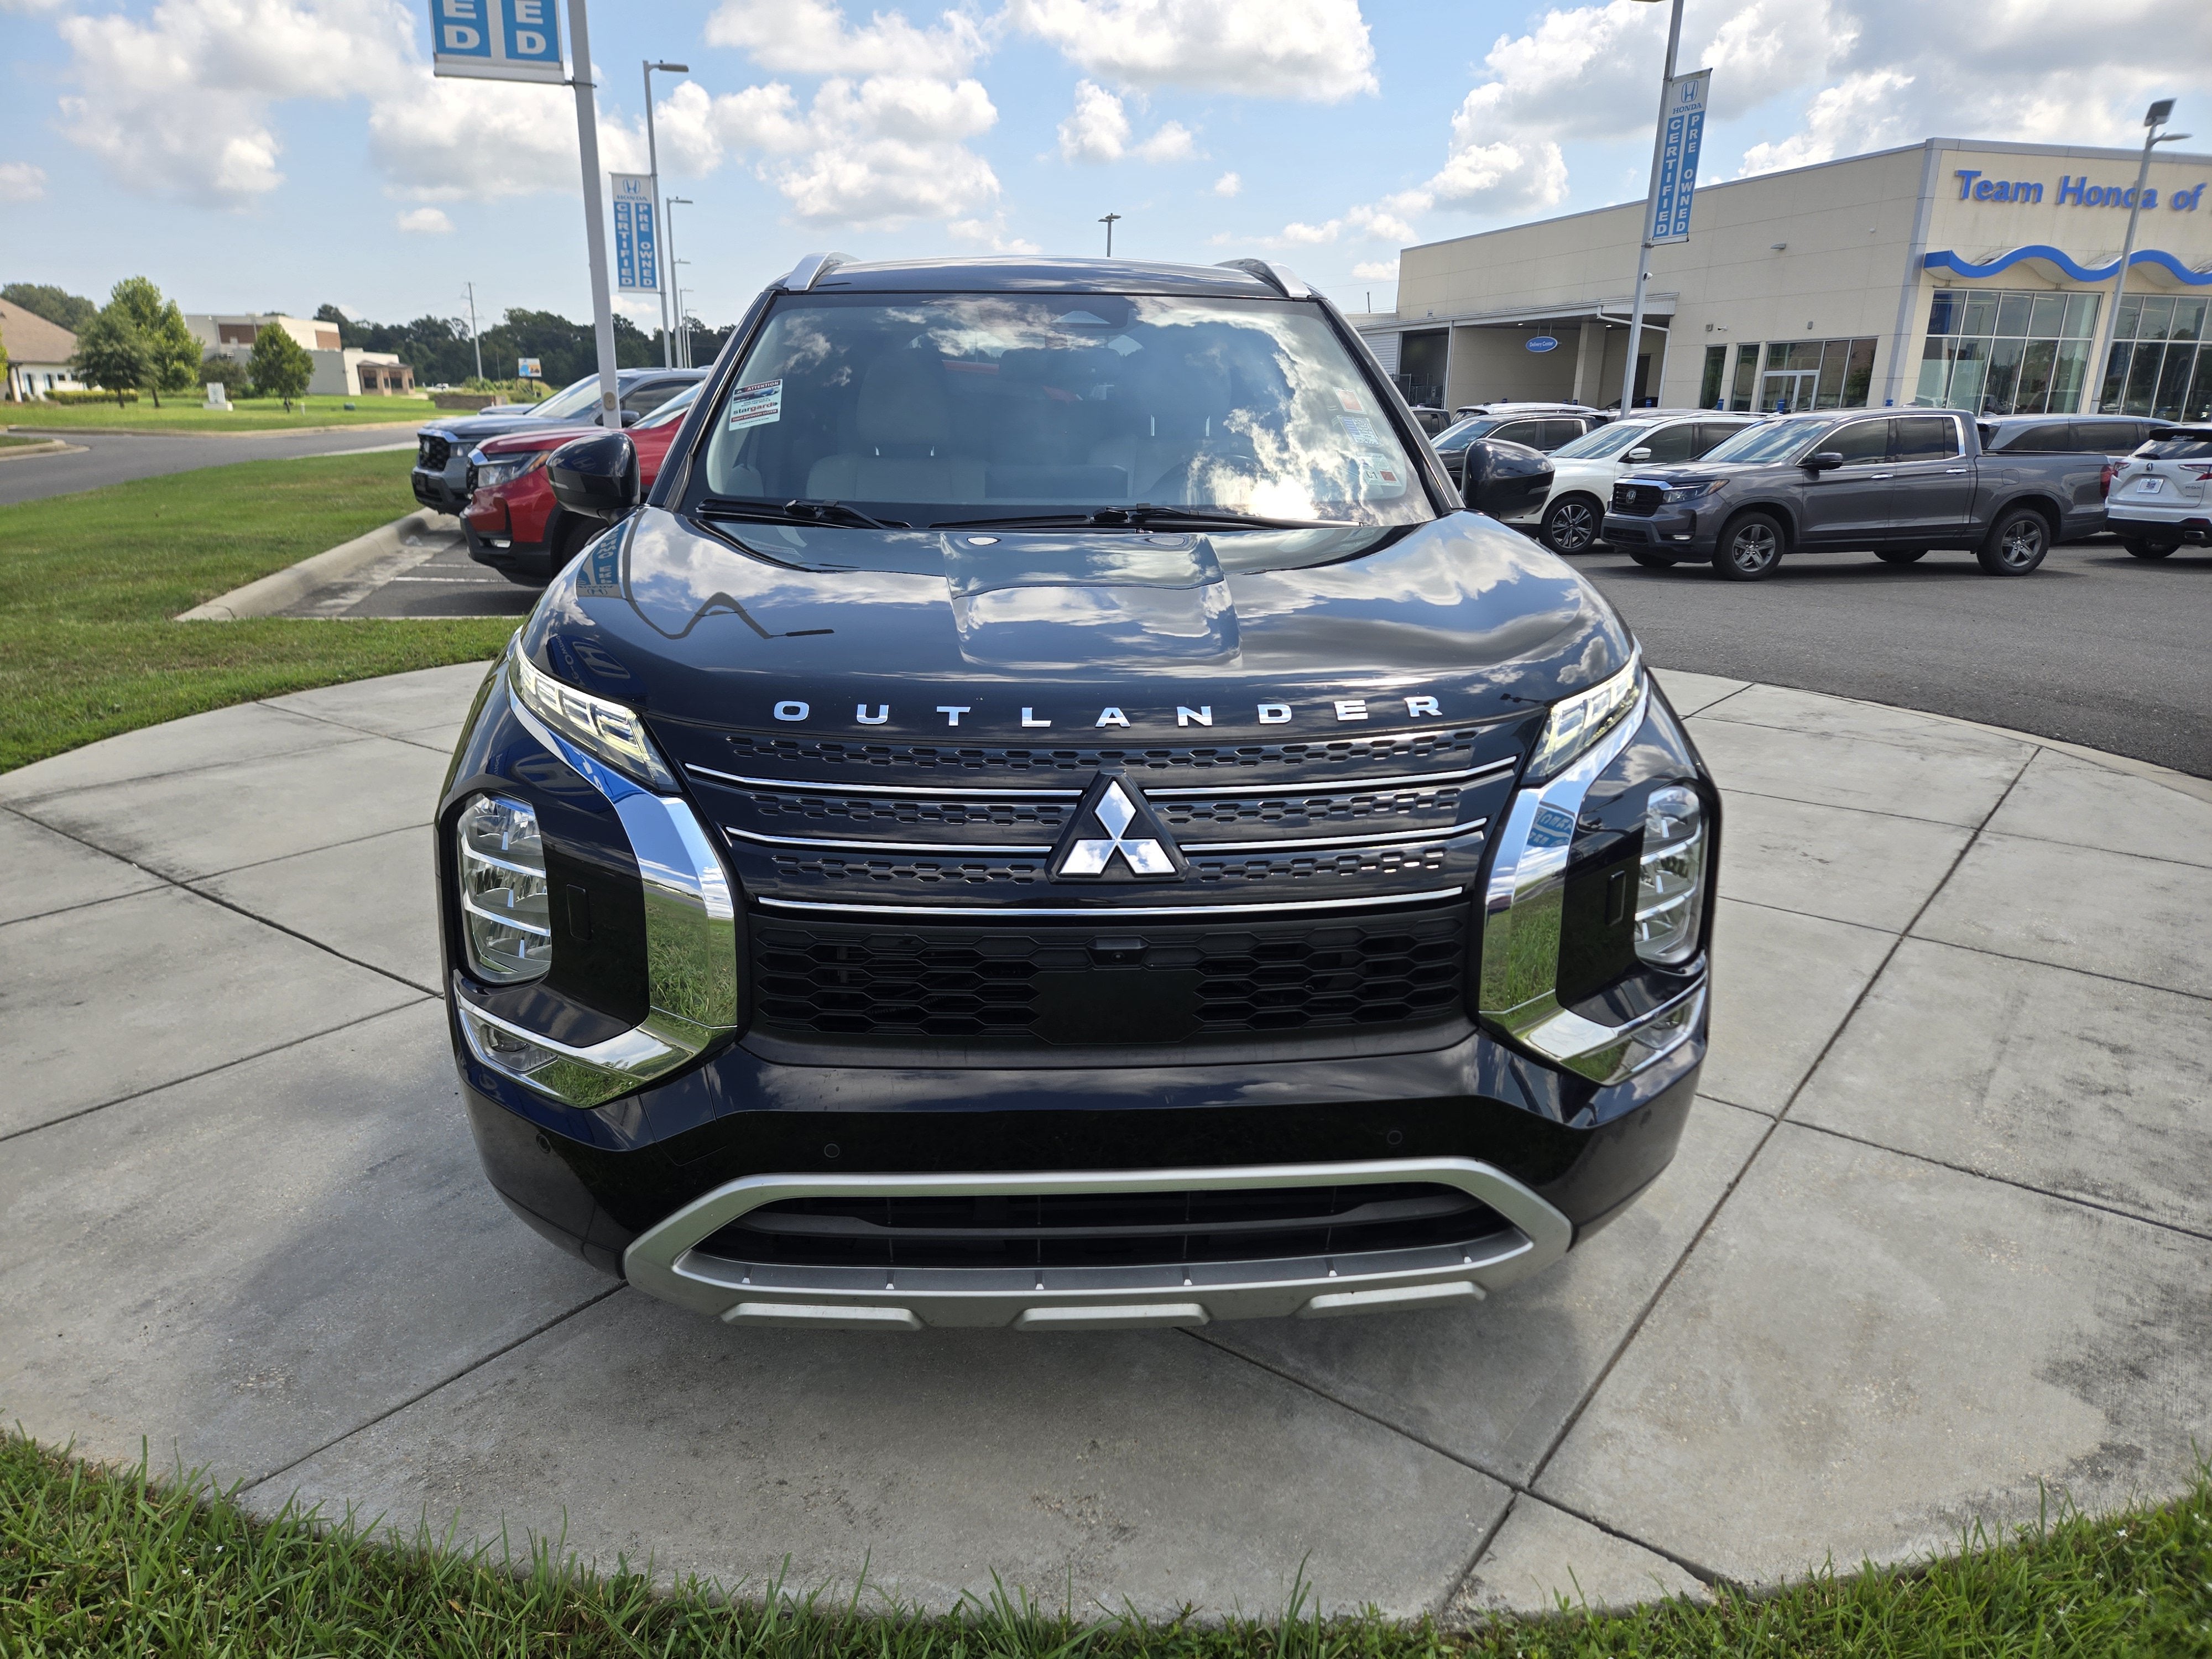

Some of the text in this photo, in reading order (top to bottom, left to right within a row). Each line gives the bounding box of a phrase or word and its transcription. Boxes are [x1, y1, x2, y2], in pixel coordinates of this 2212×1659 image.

[1673, 102, 1702, 114] HONDA
[1656, 119, 1682, 235] CERTIFIED
[1676, 115, 1700, 232] PRE OWNED
[1955, 169, 2044, 204] Team
[2172, 182, 2208, 211] of
[617, 204, 633, 285] CERTIFIED
[639, 204, 653, 286] PRE OWNED
[747, 381, 779, 391] ATTENTION
[774, 696, 1442, 727] OUTLANDER
